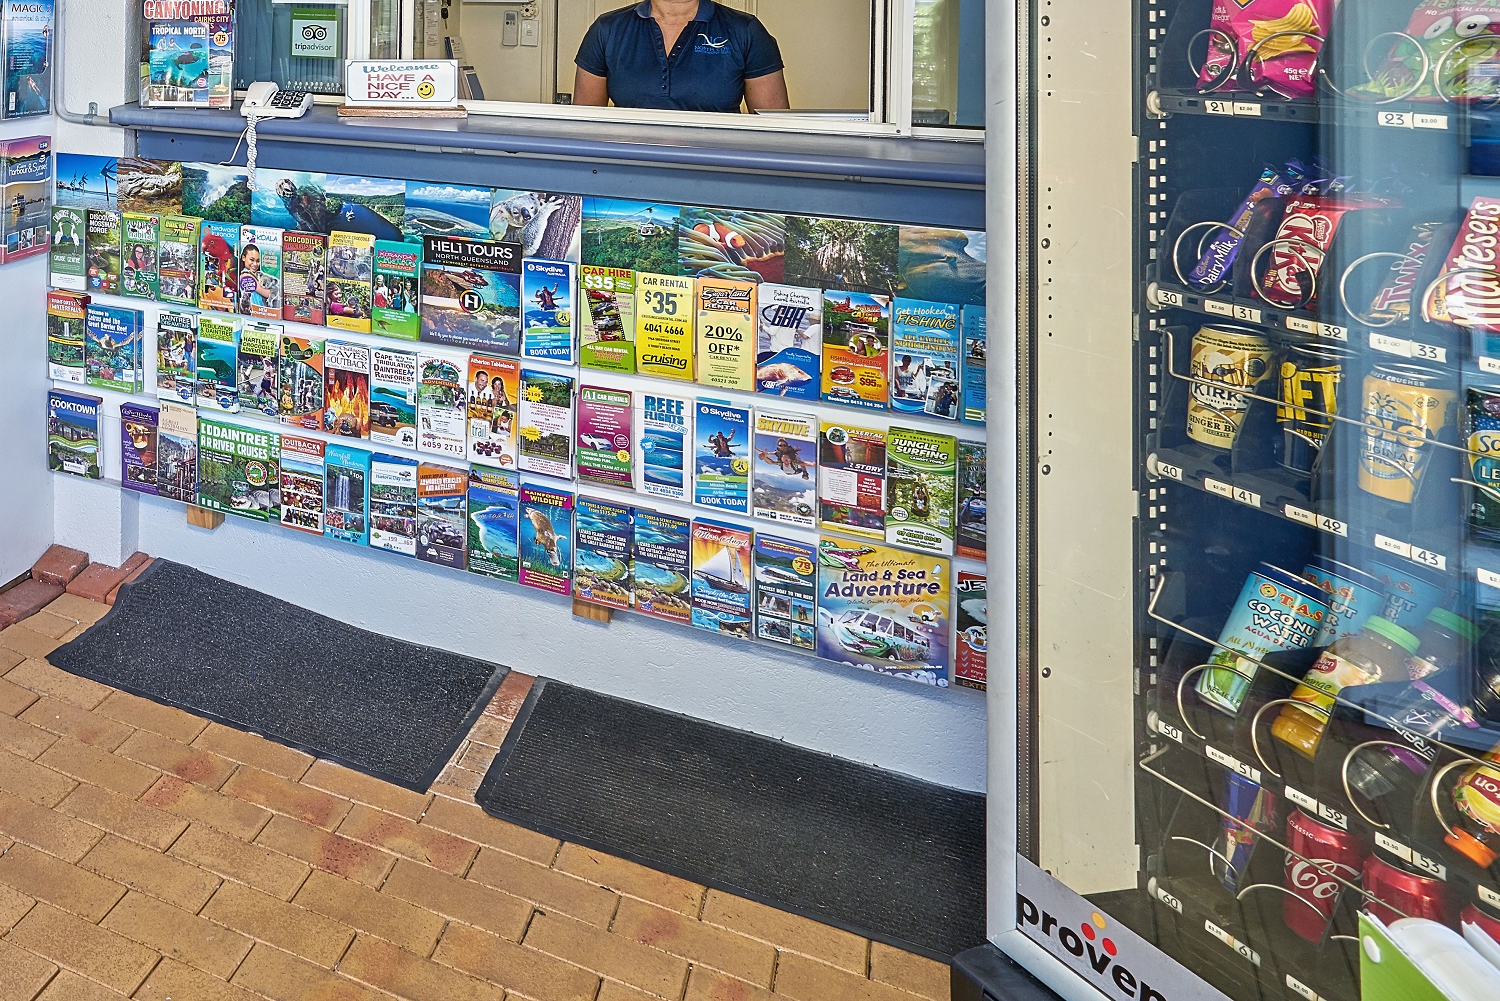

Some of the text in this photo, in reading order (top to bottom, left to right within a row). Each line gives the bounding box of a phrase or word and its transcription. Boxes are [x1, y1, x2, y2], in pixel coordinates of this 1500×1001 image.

[11, 3, 45, 13] MAGIC
[144, 0, 224, 19] CANYONING
[184, 27, 205, 35] NORTH
[295, 43, 332, 51] tripadvisor
[363, 64, 439, 73] Welcome
[1211, 101, 1226, 113] 21
[1384, 113, 1405, 125] 23
[466, 244, 513, 259] TOURS
[461, 256, 509, 266] QUEENSLAND
[583, 267, 631, 279] CAR HIRE
[584, 275, 614, 290] $35
[643, 277, 688, 289] CAR RENTAL
[1162, 292, 1177, 303] 30
[644, 323, 684, 336] 4041 4666
[704, 325, 743, 341] 20%
[1417, 345, 1437, 358] 33
[642, 354, 687, 370] cruising
[50, 398, 96, 416] COOKTOWN
[645, 395, 684, 416] REEF
[644, 411, 684, 425] FLIGHTS
[710, 408, 741, 419] Skydive
[213, 427, 268, 447] DAINTREE
[212, 437, 268, 460] RIVER CRUISES
[422, 442, 463, 453] 4059 2713
[892, 438, 940, 451] JUNGLE
[895, 446, 948, 460] SURFING
[1162, 465, 1177, 478] 40
[701, 497, 746, 506] BOOK TODAY
[1238, 490, 1253, 503] 41
[1323, 518, 1341, 532] 42
[1417, 551, 1438, 565] 43
[842, 568, 926, 583] Land & Sea
[825, 580, 940, 598] Adventure
[1247, 599, 1320, 638] COCONUT
[1253, 614, 1308, 648] WATER
